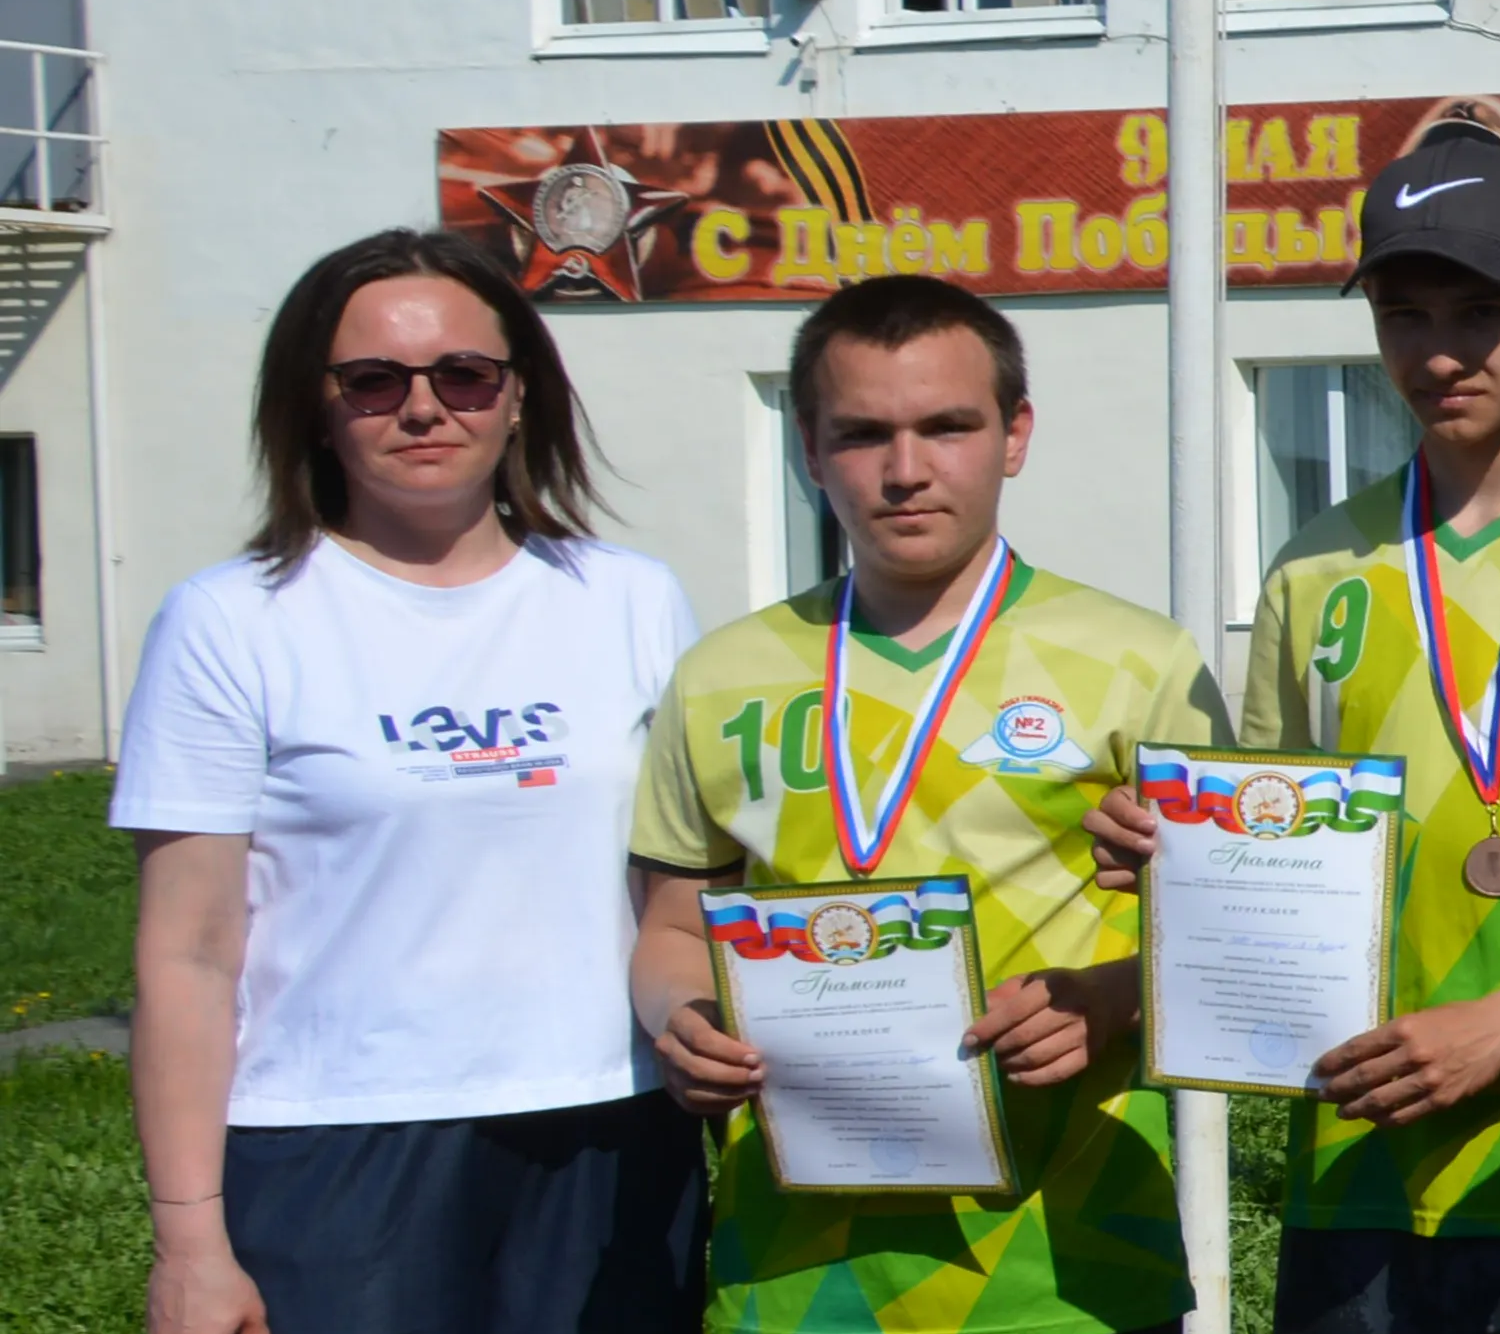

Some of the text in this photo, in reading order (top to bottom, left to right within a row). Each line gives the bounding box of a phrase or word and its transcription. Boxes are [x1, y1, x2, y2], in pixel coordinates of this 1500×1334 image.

[1117, 114, 1168, 186] 9
[694, 191, 1367, 288] С Днём Побды!
[1312, 576, 1371, 684] 9
[722, 688, 852, 802] 10
[1015, 717, 1045, 731] №2
[1208, 842, 1323, 873] Грамота
[791, 969, 907, 1001] Грамота
